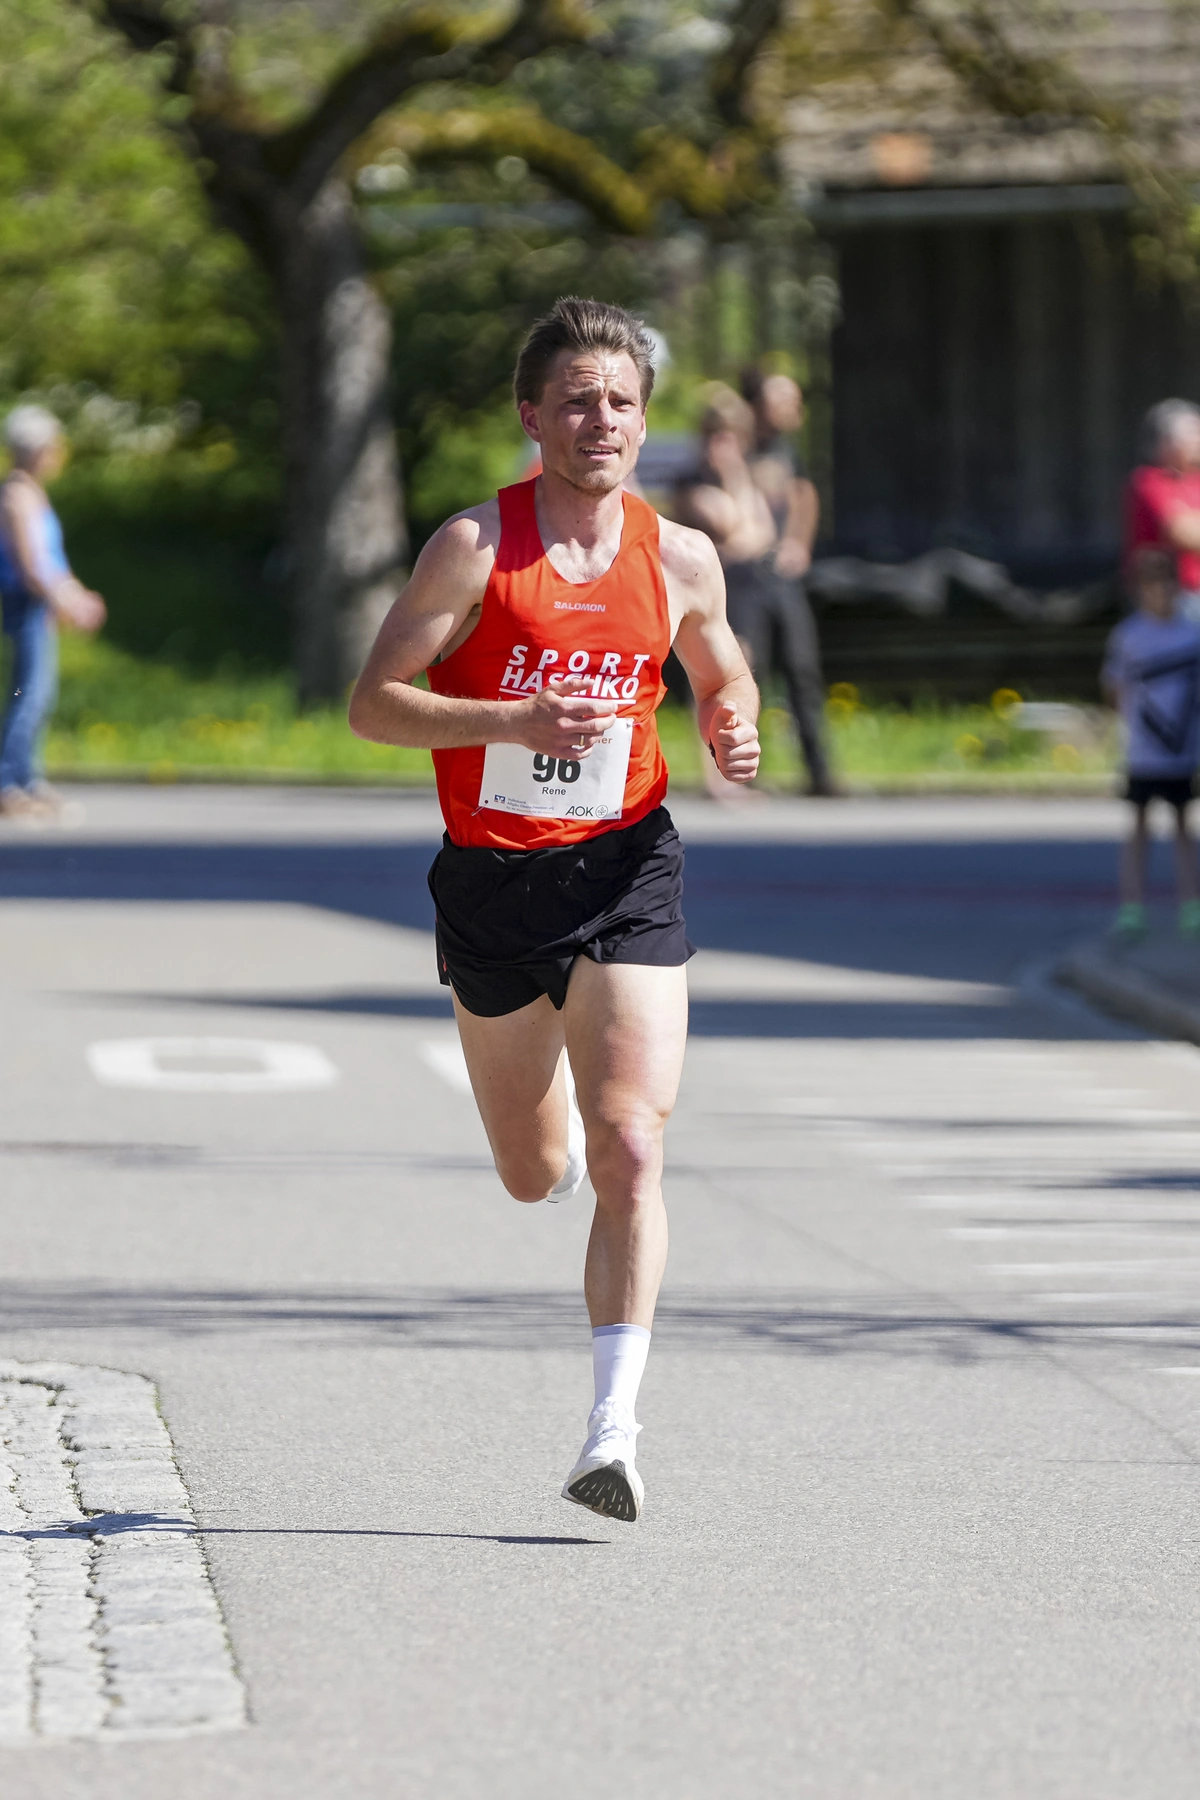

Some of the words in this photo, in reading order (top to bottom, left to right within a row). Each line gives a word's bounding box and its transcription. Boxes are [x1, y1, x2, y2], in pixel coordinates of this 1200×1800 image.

[553, 600, 606, 613] SALOMON
[508, 644, 651, 677] SPORT
[532, 751, 581, 783] 96
[541, 786, 567, 796] Rene
[565, 805, 594, 817] AOK
